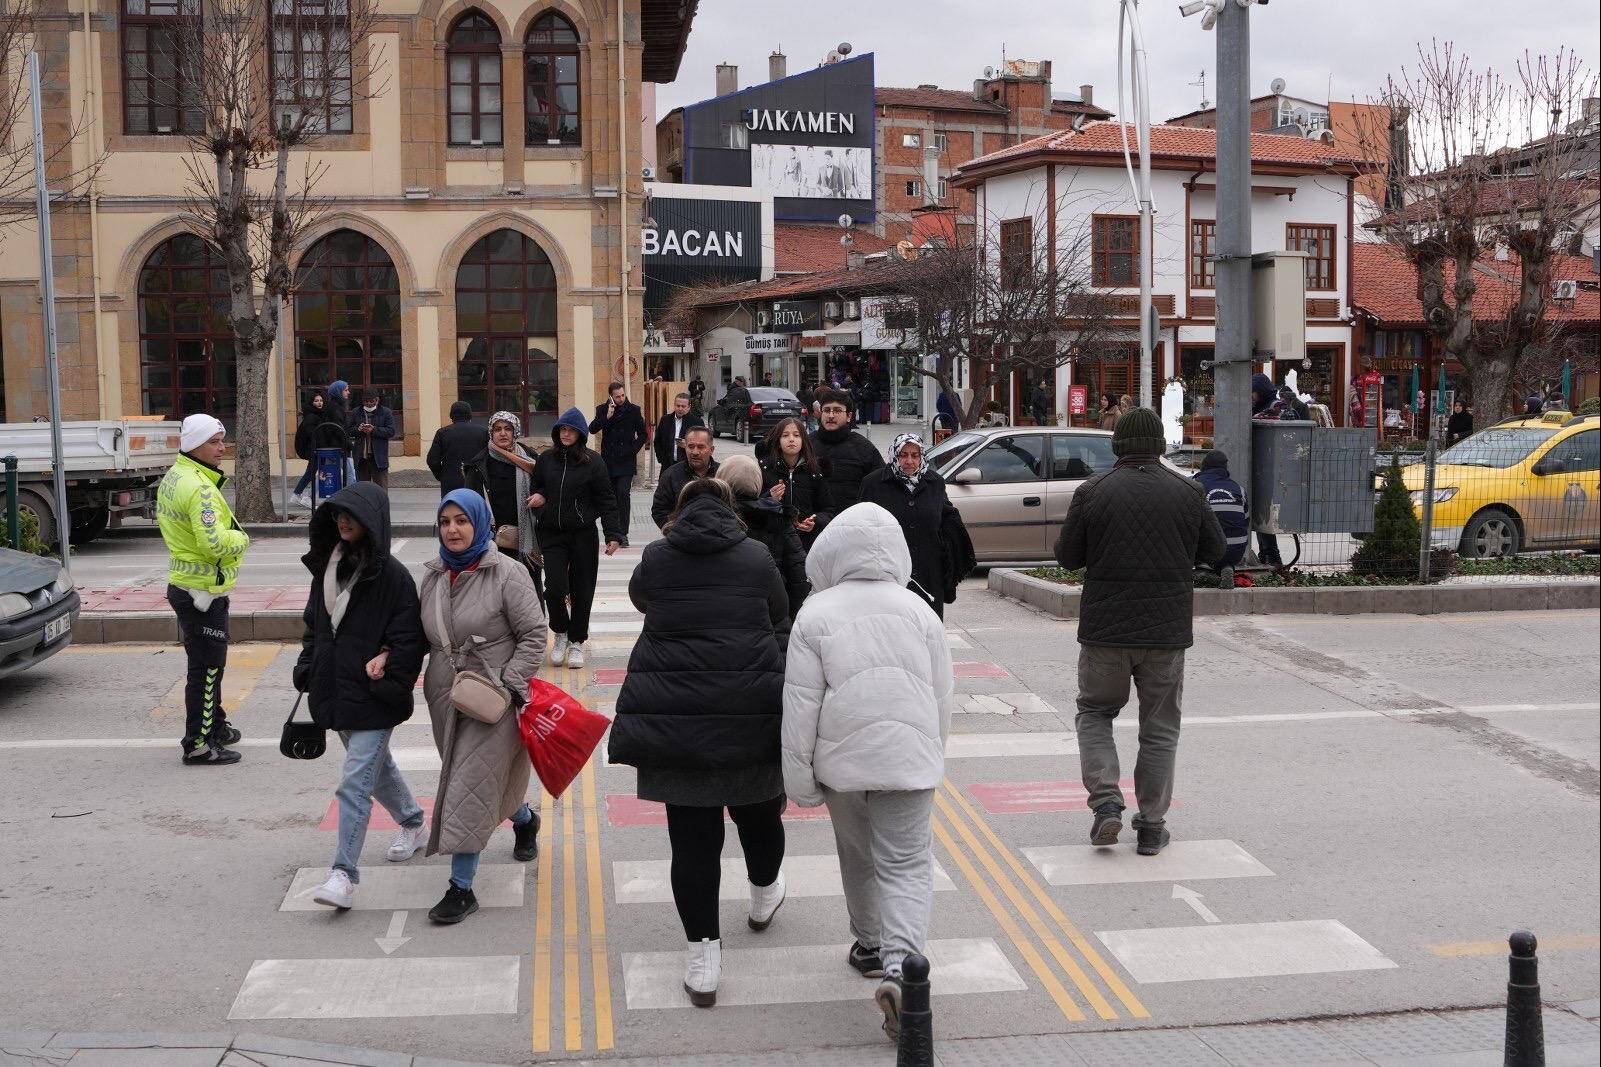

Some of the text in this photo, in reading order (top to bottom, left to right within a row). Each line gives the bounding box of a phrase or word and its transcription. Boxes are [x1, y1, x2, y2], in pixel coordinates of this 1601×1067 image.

[746, 109, 854, 134] JAKAMEN
[641, 228, 743, 257] BACAN
[745, 337, 772, 350] GÜMÜŞ
[773, 338, 789, 348] TAKI
